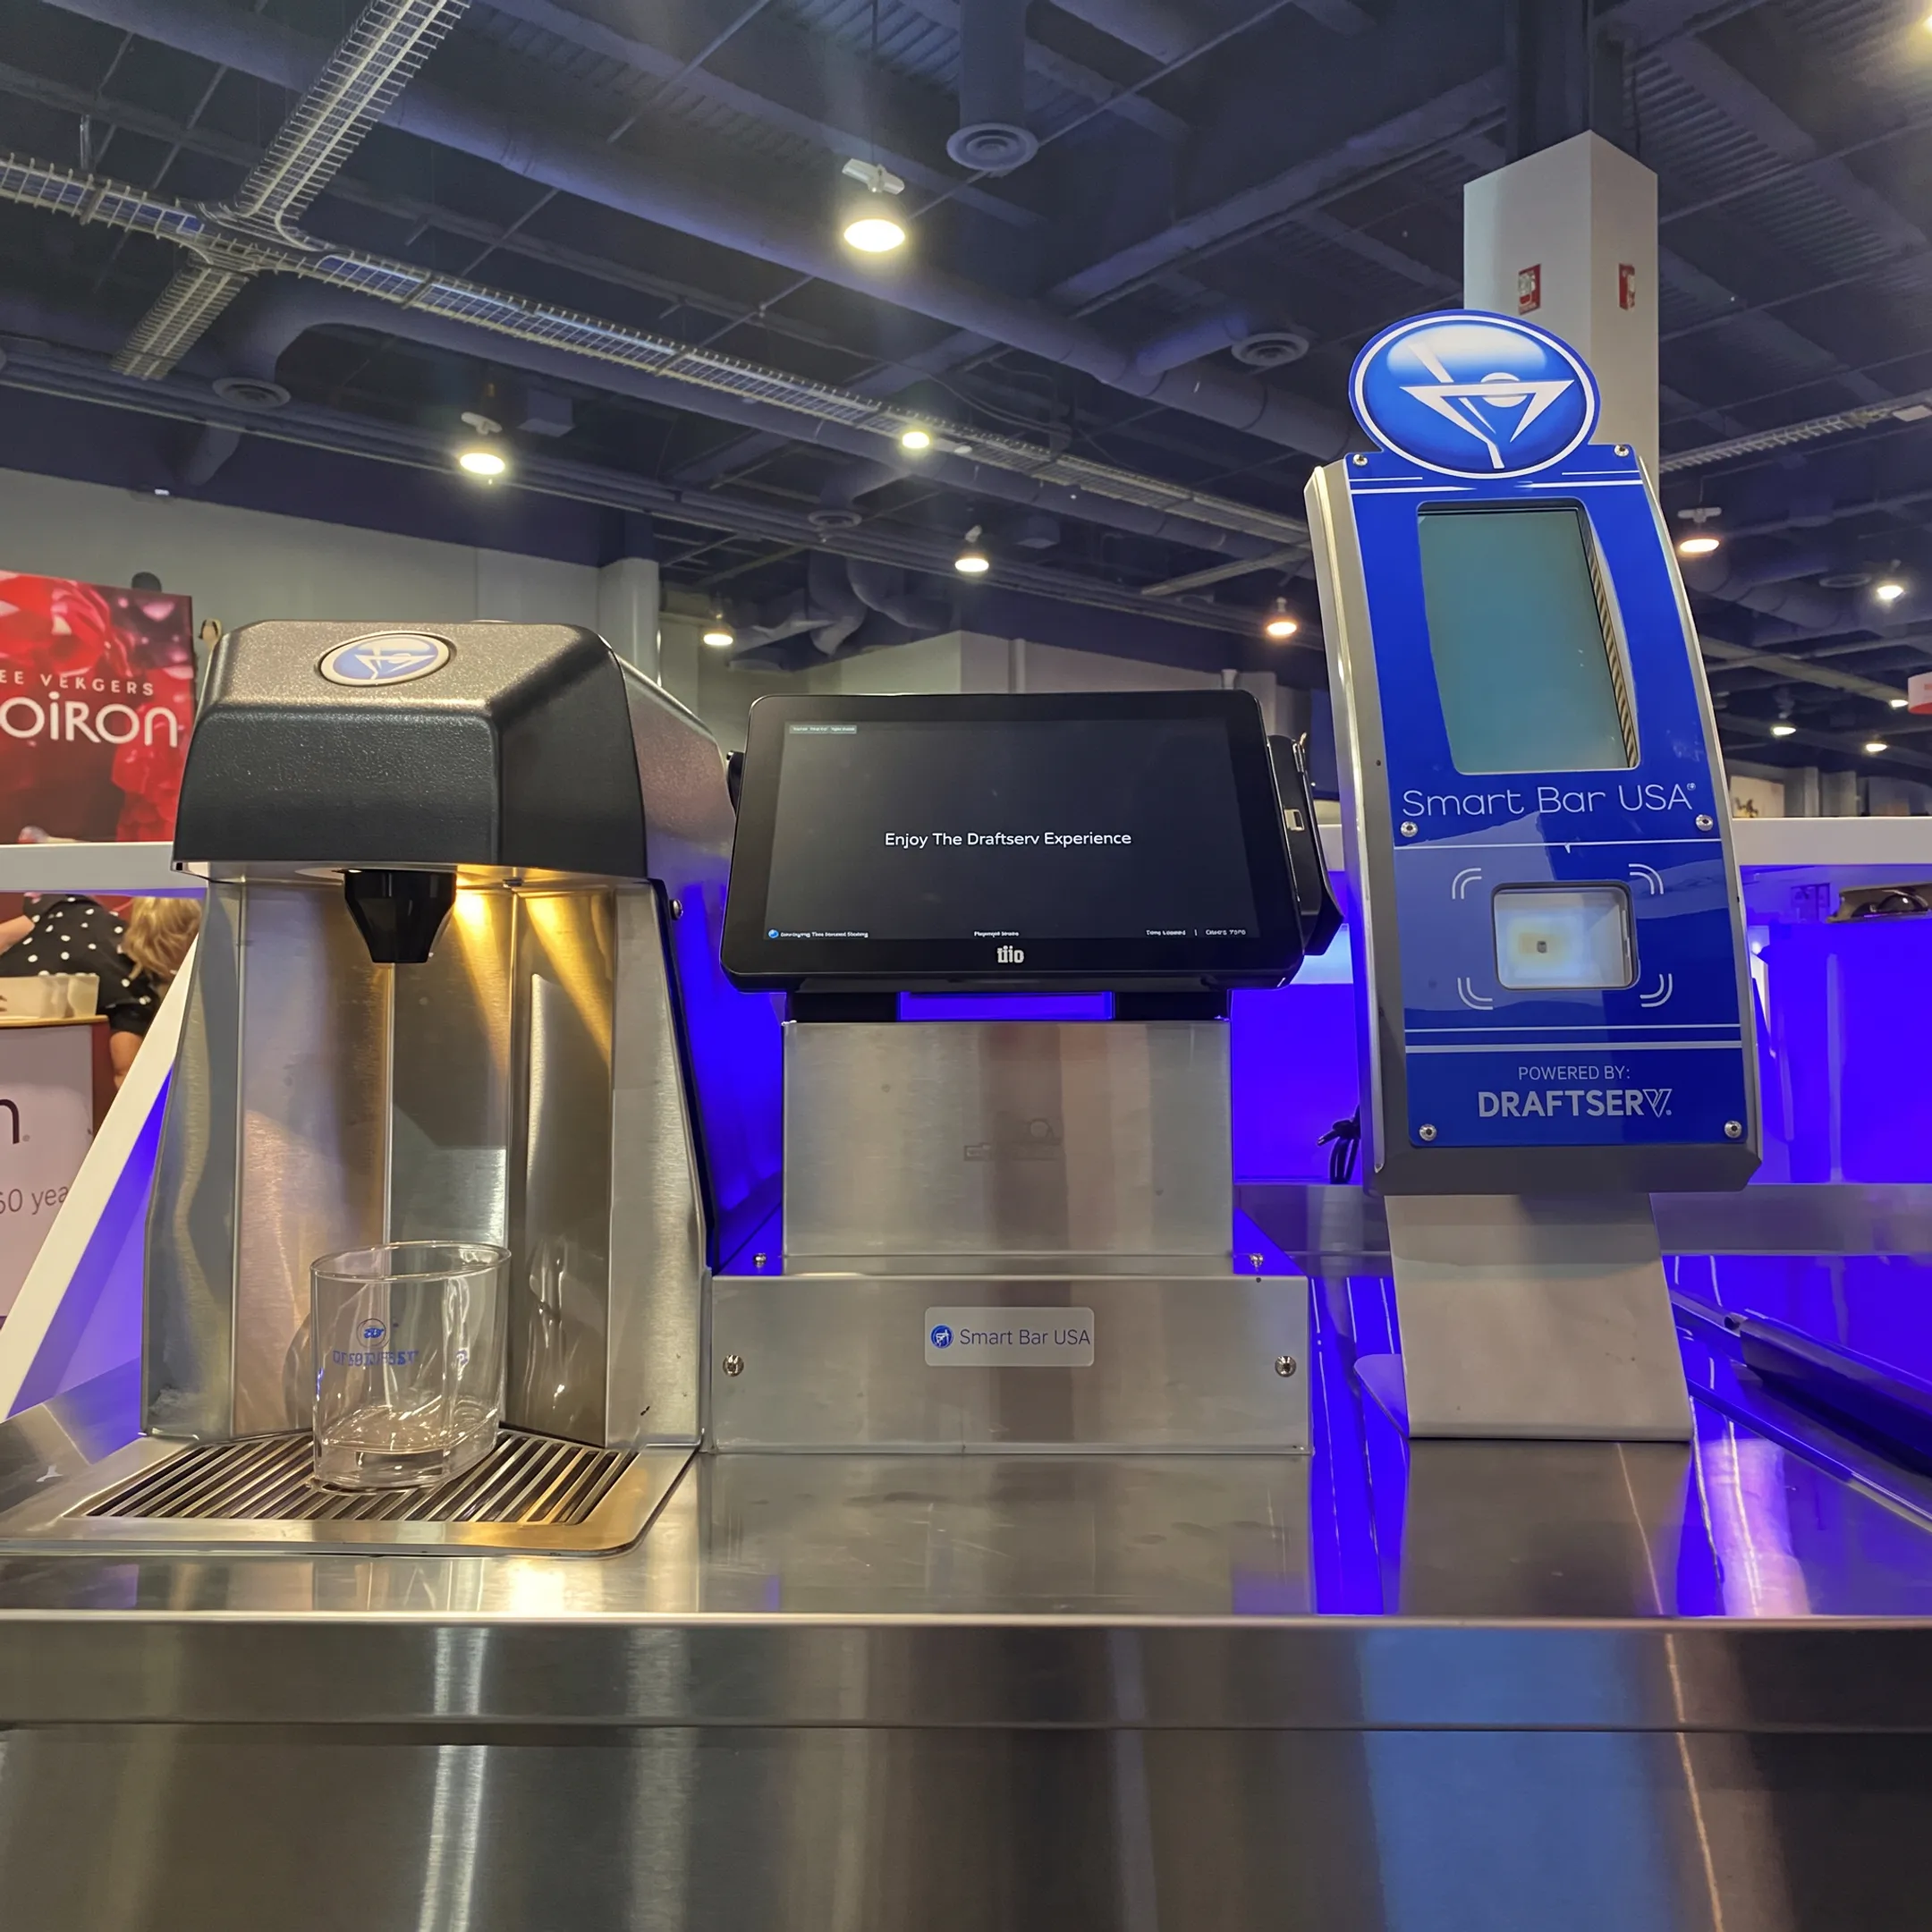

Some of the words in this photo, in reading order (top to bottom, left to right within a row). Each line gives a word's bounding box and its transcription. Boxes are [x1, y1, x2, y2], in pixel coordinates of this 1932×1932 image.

[1402, 789, 1524, 817] Smart
[1537, 786, 1606, 813] Bar
[885, 833, 928, 849] Enjoy
[932, 833, 962, 845] The
[967, 832, 1039, 846] Draftserv
[1044, 832, 1131, 848] Experience
[1518, 1065, 1599, 1080] POWERED
[1604, 1065, 1631, 1080] BY:
[960, 1329, 1013, 1345] Smart
[1019, 1329, 1048, 1345] Bar
[1054, 1329, 1091, 1345] USA
